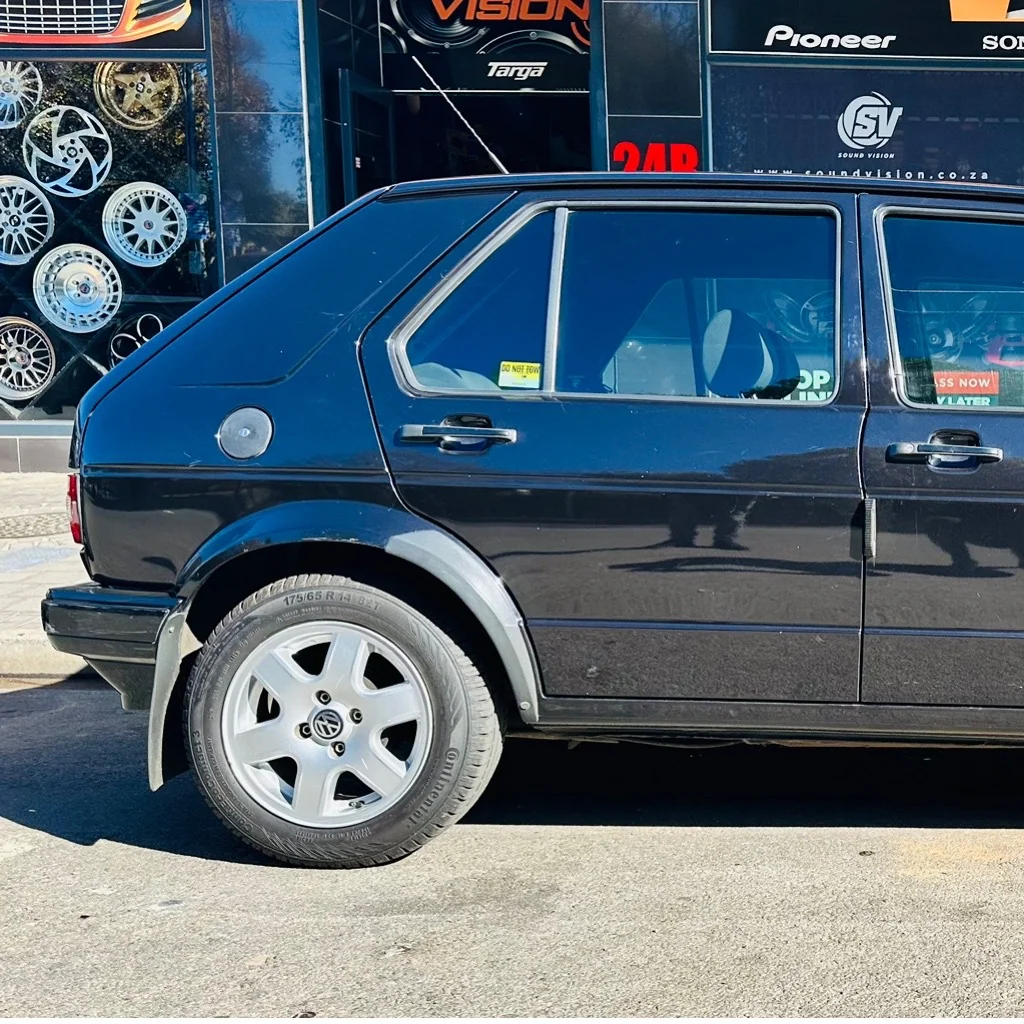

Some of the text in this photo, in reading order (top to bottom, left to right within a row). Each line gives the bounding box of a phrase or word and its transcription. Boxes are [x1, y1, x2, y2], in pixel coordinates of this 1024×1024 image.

[431, 0, 589, 20] VISION
[764, 25, 897, 49] Pioneer
[487, 61, 548, 81] Targa
[796, 369, 831, 390] OP
[959, 378, 991, 388] NOW
[948, 396, 990, 406] LATER
[283, 590, 322, 606] 175/65
[325, 591, 336, 601] R
